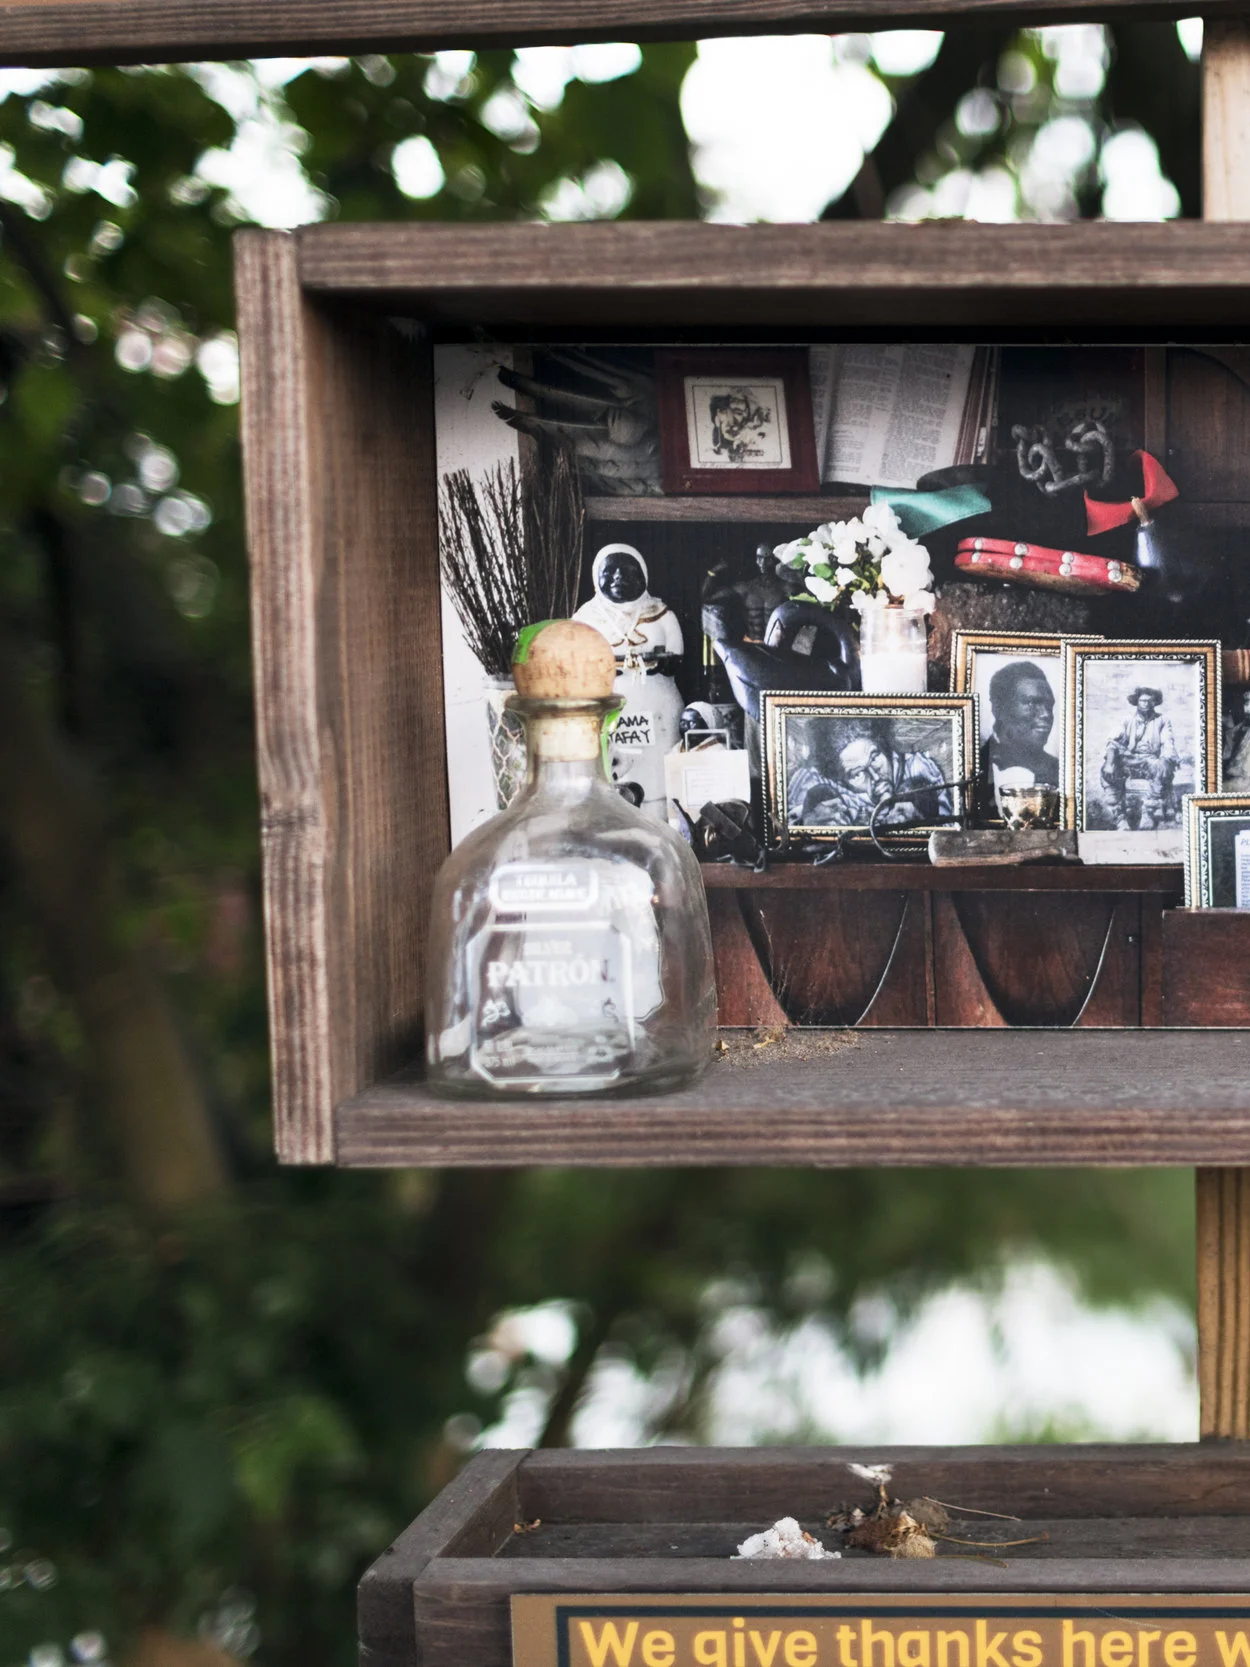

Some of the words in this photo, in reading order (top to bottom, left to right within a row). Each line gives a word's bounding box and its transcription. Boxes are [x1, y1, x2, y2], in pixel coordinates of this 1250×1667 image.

[579, 1621, 675, 1667] We
[693, 1617, 818, 1667] give
[836, 1619, 1044, 1667] thanks
[1063, 1619, 1197, 1667] here
